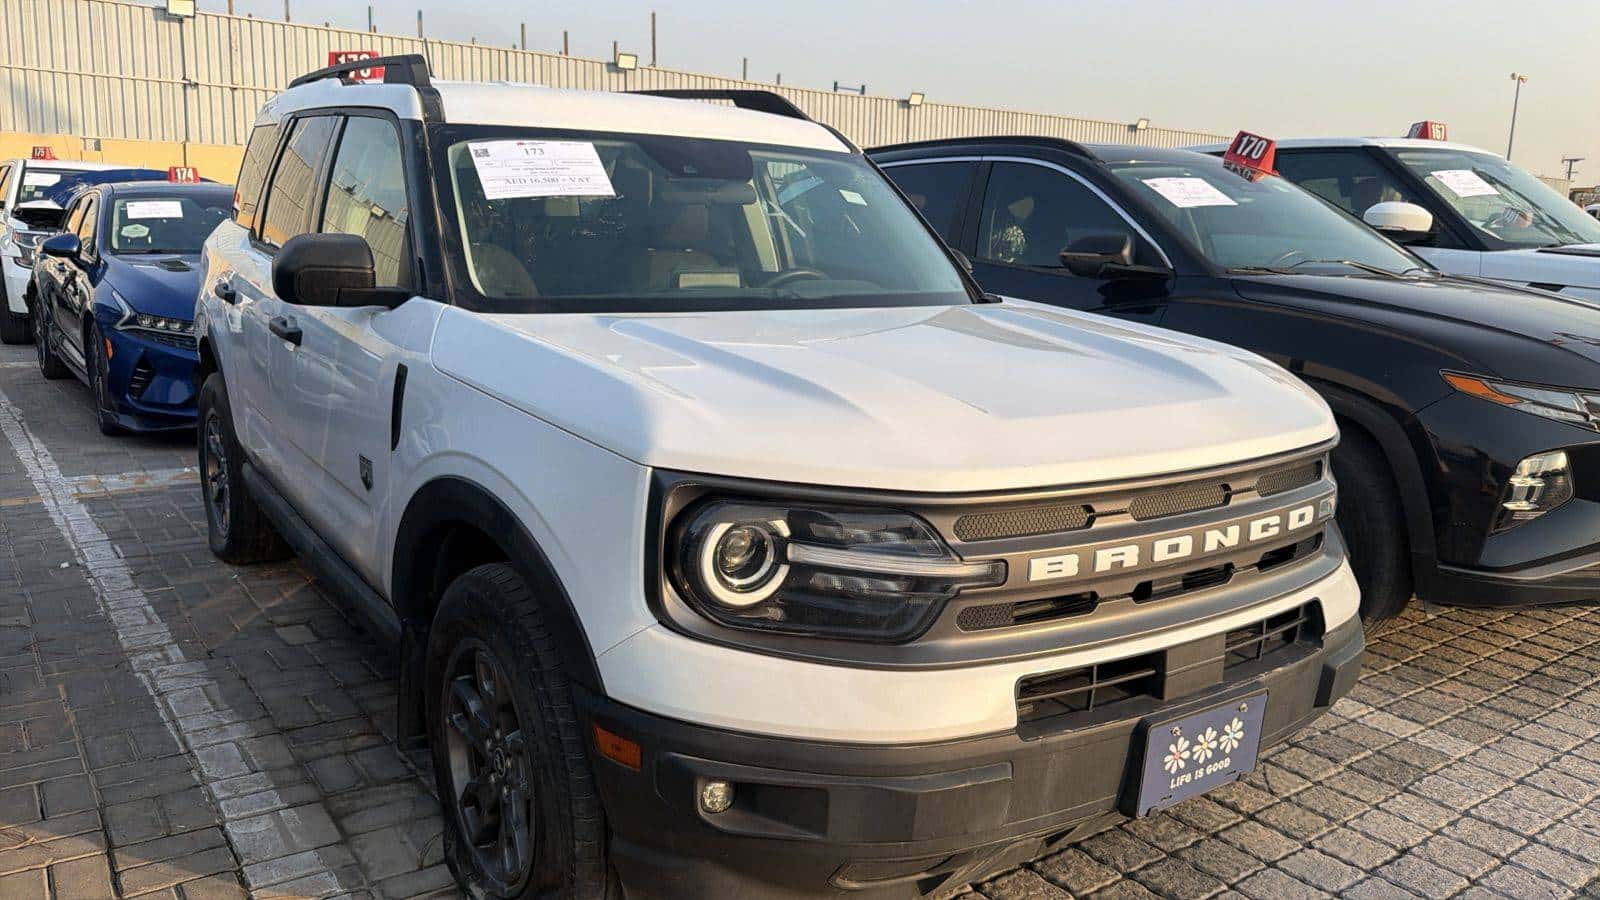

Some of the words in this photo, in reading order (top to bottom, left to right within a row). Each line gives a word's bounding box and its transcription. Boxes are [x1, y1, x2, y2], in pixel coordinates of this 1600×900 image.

[524, 147, 545, 156] 173
[1236, 135, 1267, 160] 170
[175, 167, 194, 182] 174
[504, 176, 527, 185] AED
[569, 176, 591, 184] VAT
[1028, 505, 1314, 582] BRONCO
[1194, 768, 1204, 780] IS
[1206, 757, 1231, 775] GOOD
